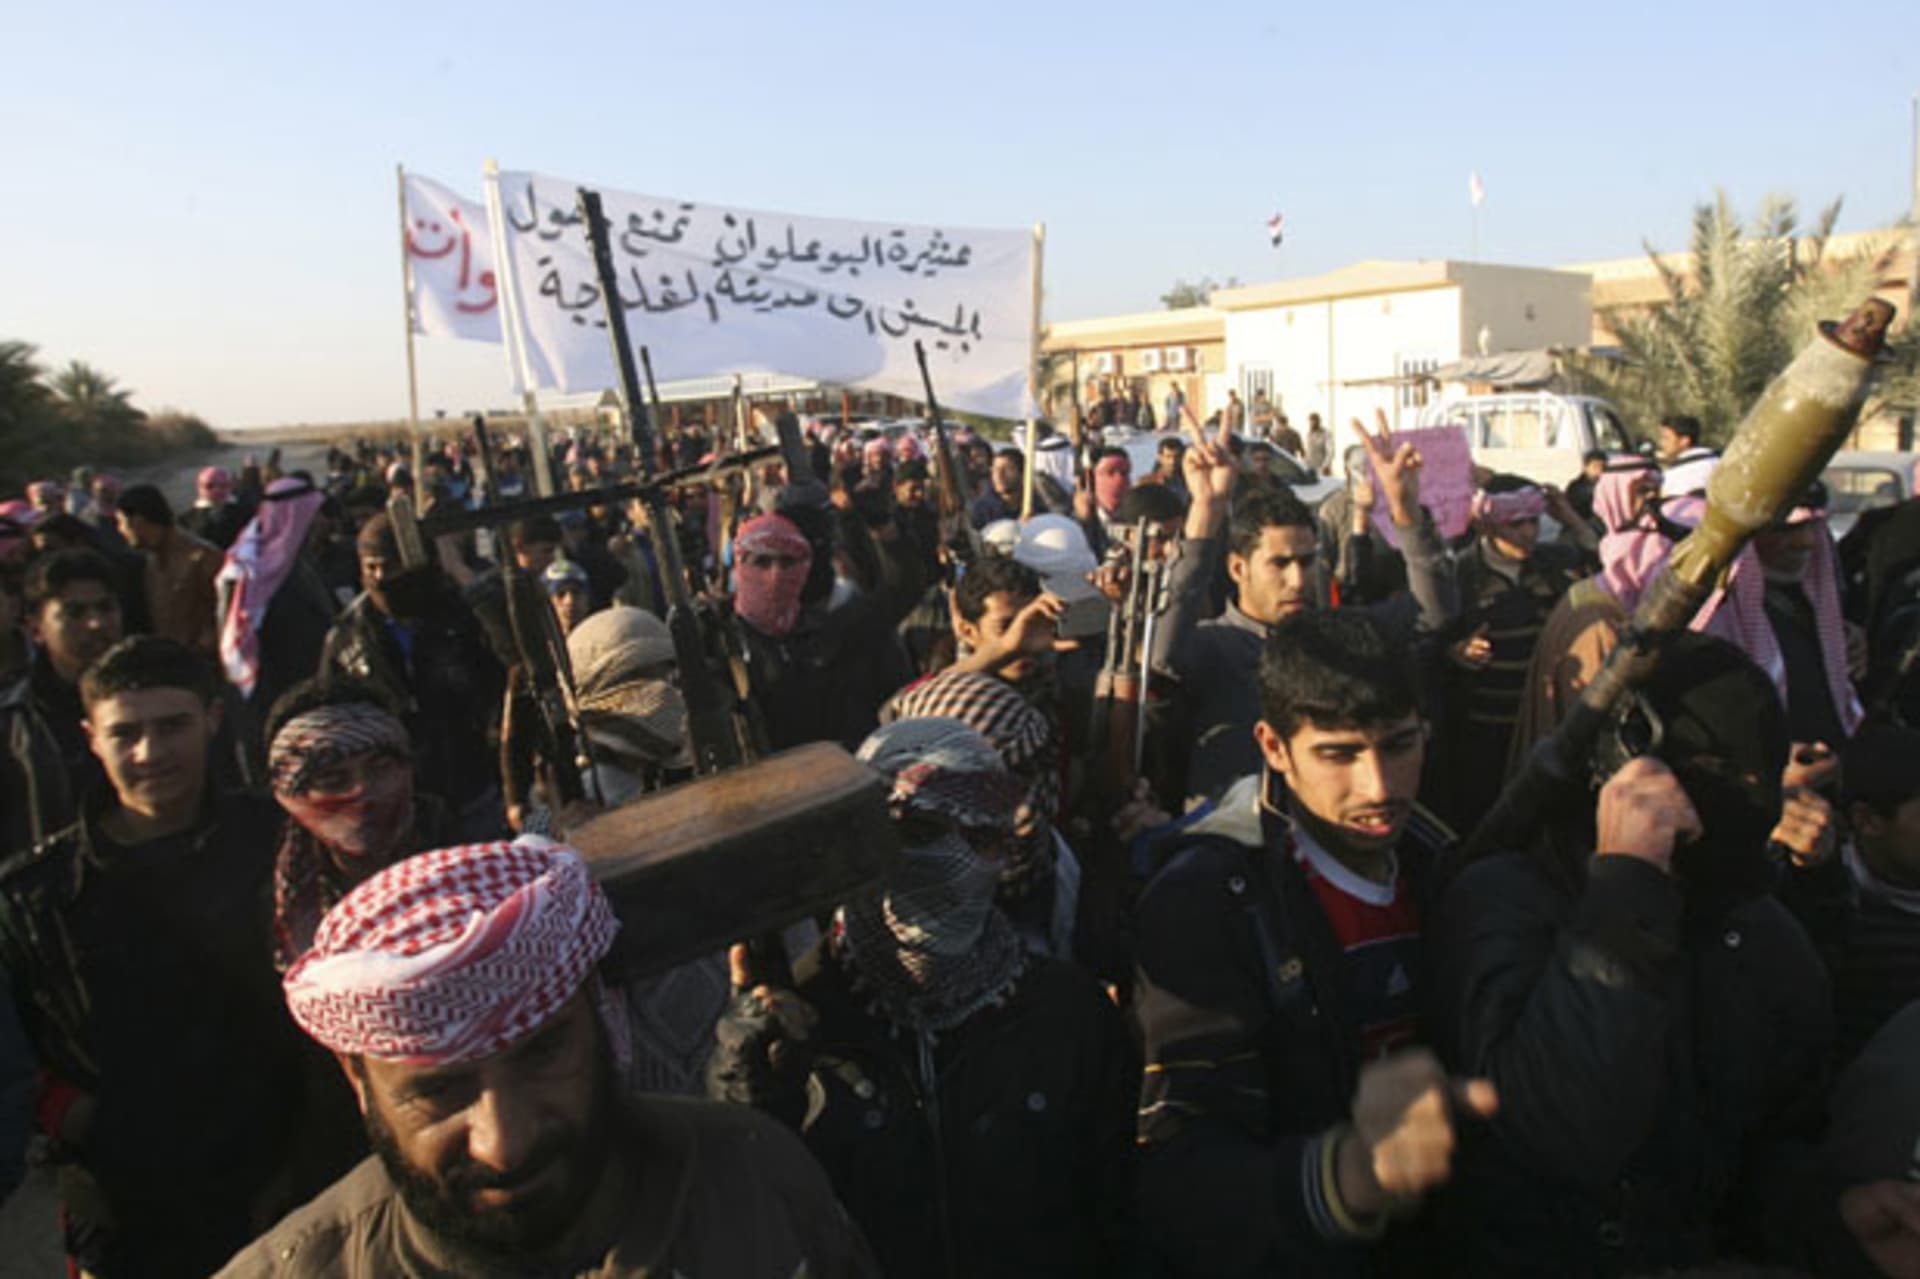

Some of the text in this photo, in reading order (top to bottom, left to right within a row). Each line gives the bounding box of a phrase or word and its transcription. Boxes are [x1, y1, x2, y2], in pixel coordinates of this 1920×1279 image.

[507, 179, 613, 242] ول
[886, 228, 973, 278] عشيرة
[537, 254, 721, 329] الفلجة
